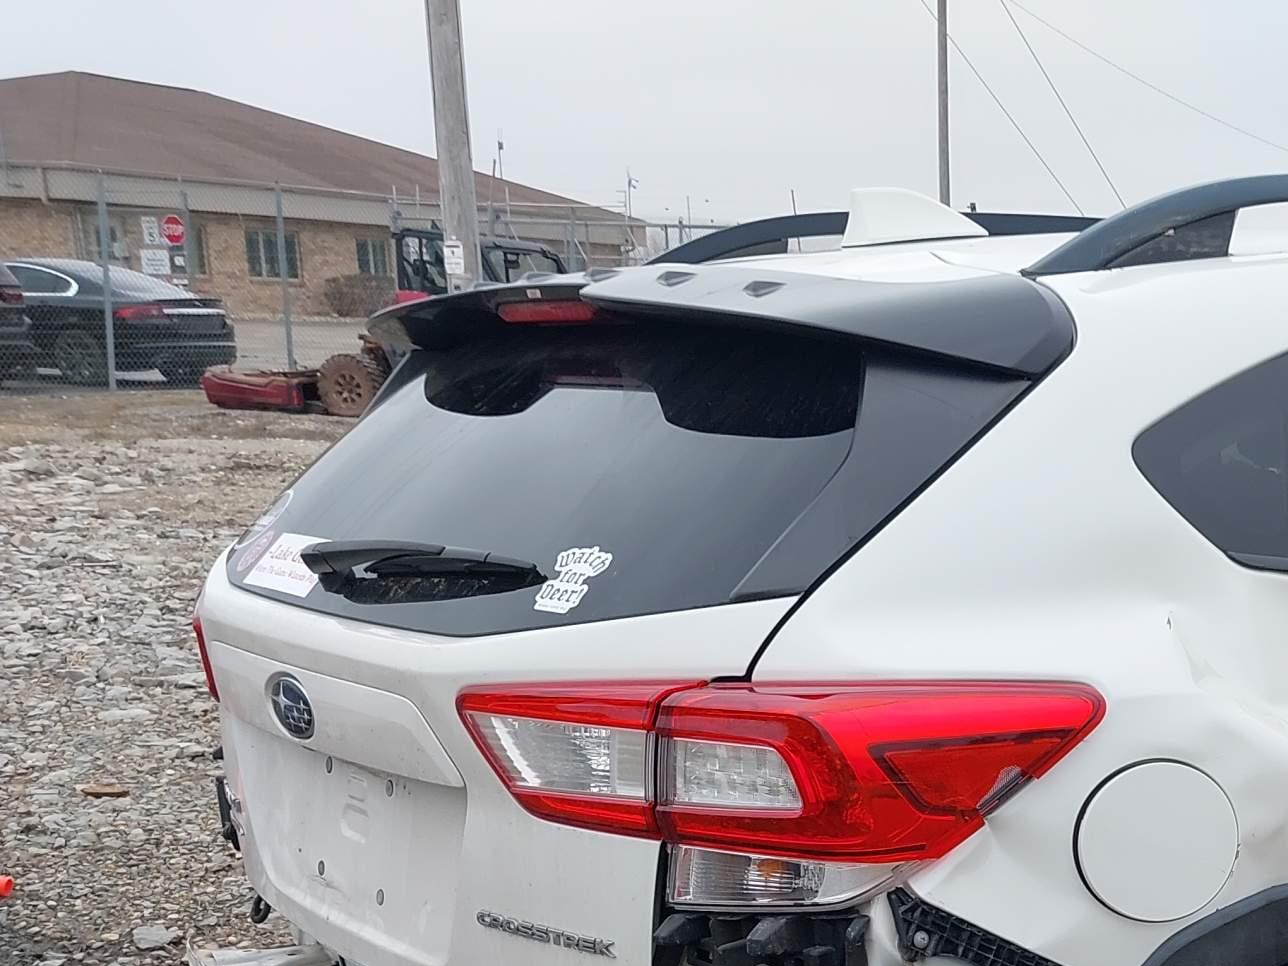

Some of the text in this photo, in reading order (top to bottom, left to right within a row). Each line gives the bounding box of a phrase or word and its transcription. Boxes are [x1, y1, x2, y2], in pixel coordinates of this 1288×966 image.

[161, 224, 184, 236] STOP
[559, 551, 609, 573] Watch
[559, 569, 586, 584] for
[540, 583, 585, 604] Deer!
[477, 910, 616, 959] CROSSTREK
